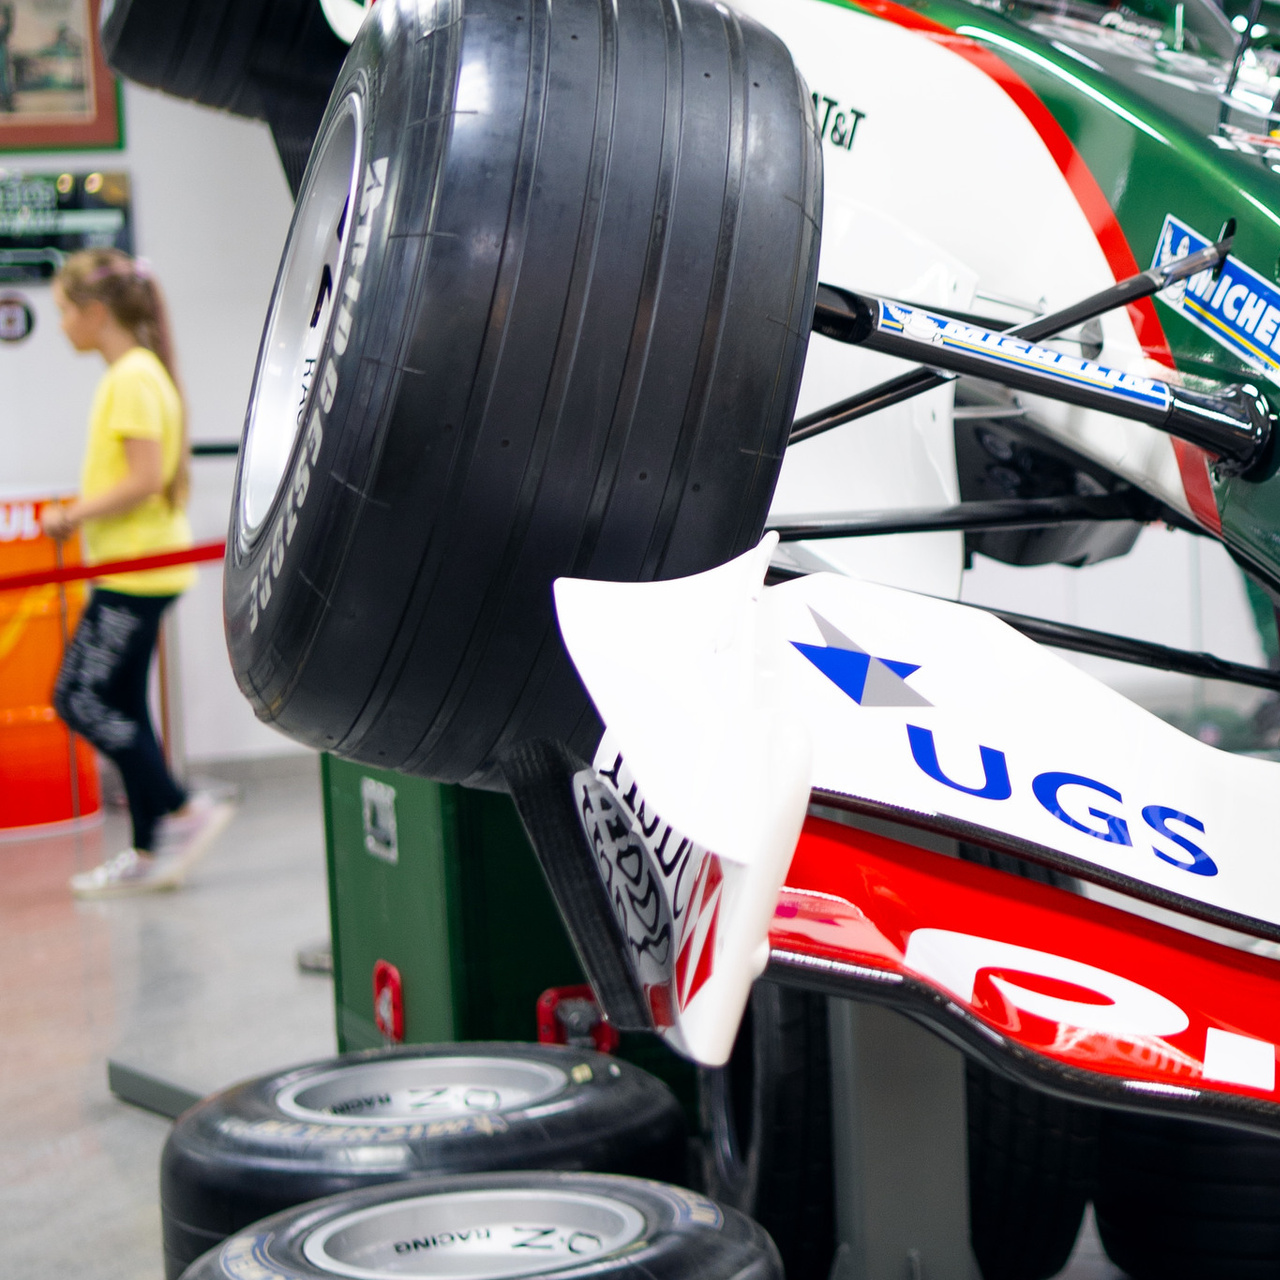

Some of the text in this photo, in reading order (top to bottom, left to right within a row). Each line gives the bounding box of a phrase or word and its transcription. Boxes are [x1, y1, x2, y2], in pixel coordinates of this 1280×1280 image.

[812, 92, 866, 151] T&T
[906, 723, 1219, 877] UGS
[392, 1228, 492, 1257] RACING
